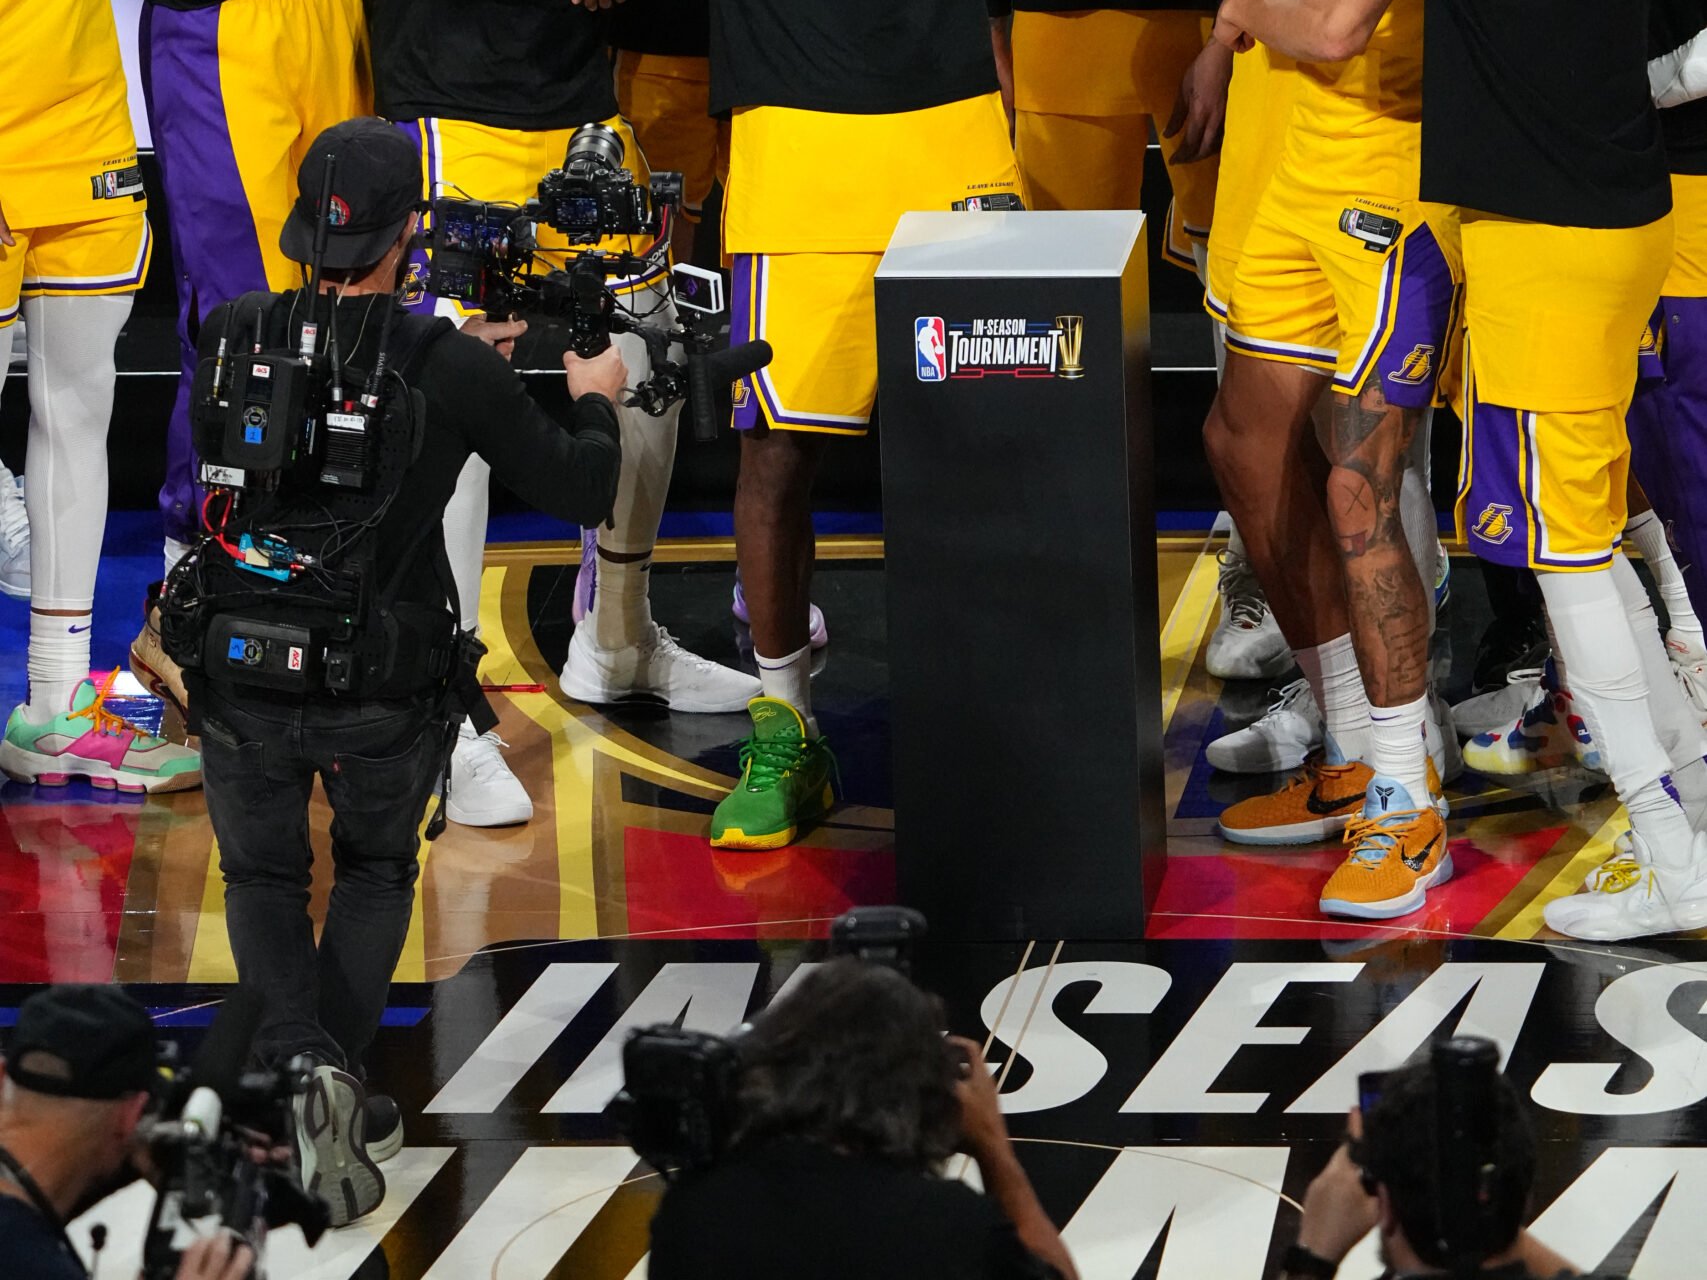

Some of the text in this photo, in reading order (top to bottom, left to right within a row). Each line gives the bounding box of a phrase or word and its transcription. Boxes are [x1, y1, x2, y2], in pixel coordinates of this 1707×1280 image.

[972, 319, 1027, 336] IN-SEASON
[948, 330, 1062, 373] TOURNAMENT
[921, 366, 936, 377] NBA
